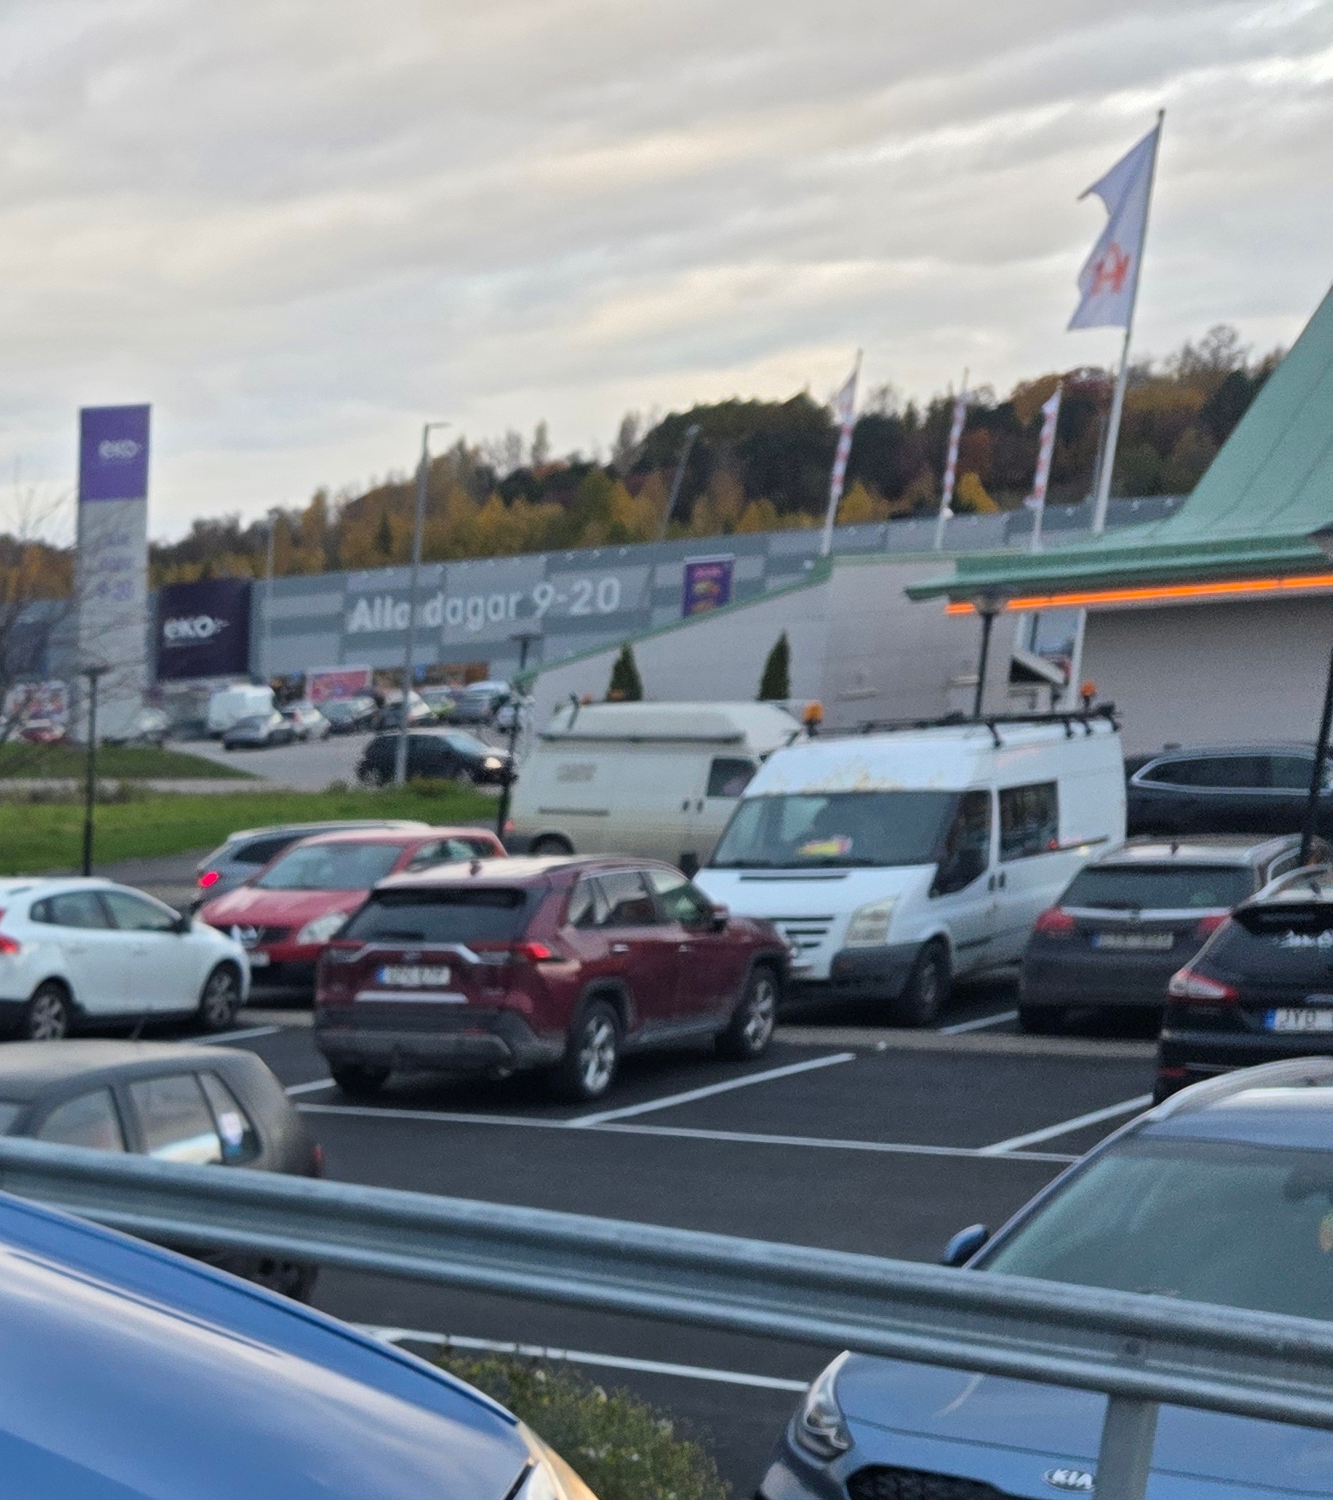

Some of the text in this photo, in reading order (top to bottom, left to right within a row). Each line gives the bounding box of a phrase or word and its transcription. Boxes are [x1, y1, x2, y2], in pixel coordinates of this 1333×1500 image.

[345, 576, 621, 634] Alla dagar 9-20
[1052, 1469, 1094, 1490] KIA
